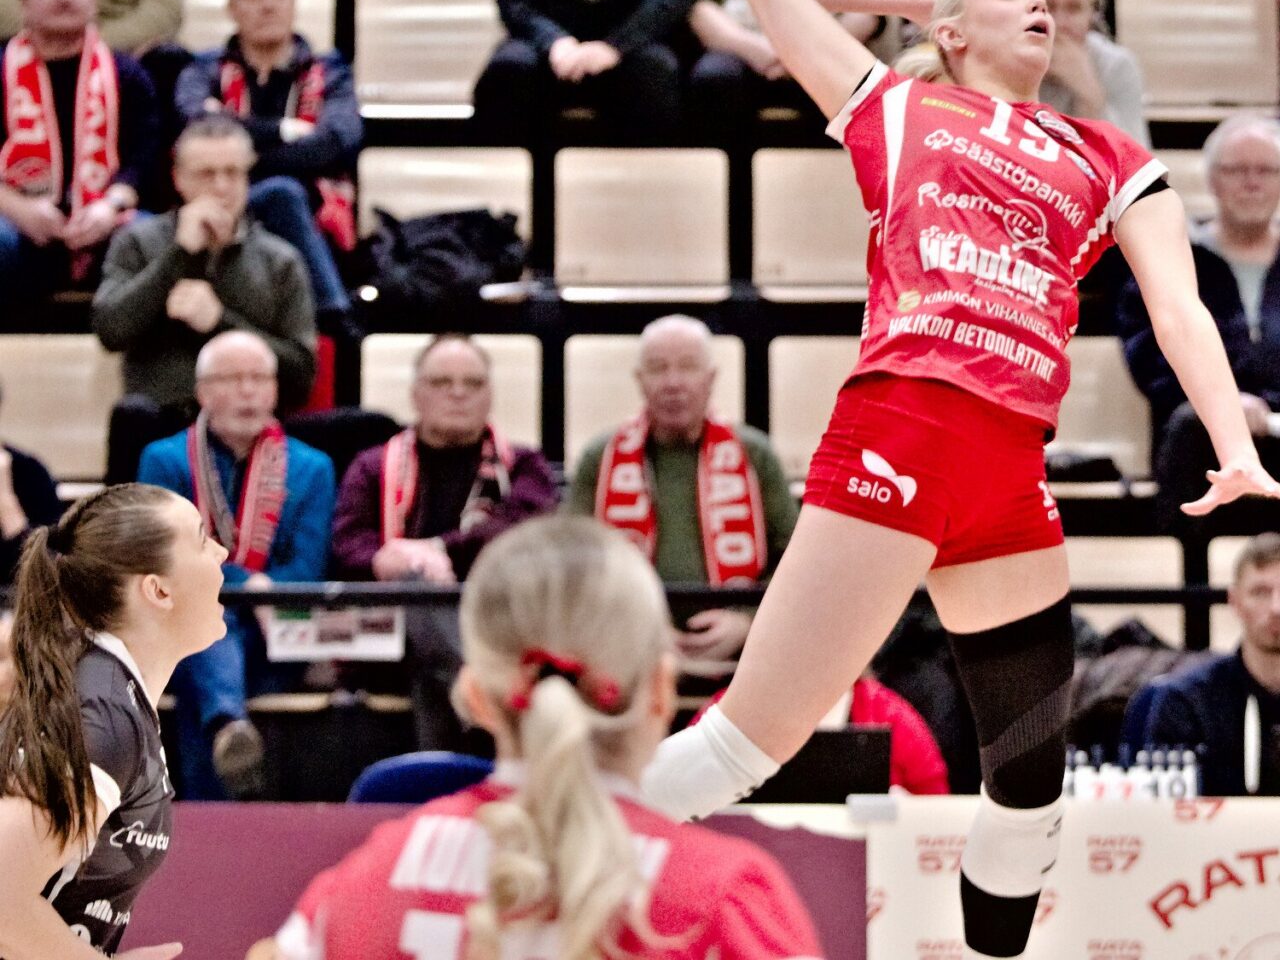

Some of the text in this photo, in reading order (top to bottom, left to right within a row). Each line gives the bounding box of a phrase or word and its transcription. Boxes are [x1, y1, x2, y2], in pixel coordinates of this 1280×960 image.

[923, 289, 982, 311] KIMMON
[952, 320, 1058, 383] BETONILATTIAT
[846, 476, 892, 504] salo
[126, 829, 170, 851] ruutu
[1089, 850, 1142, 874] 57
